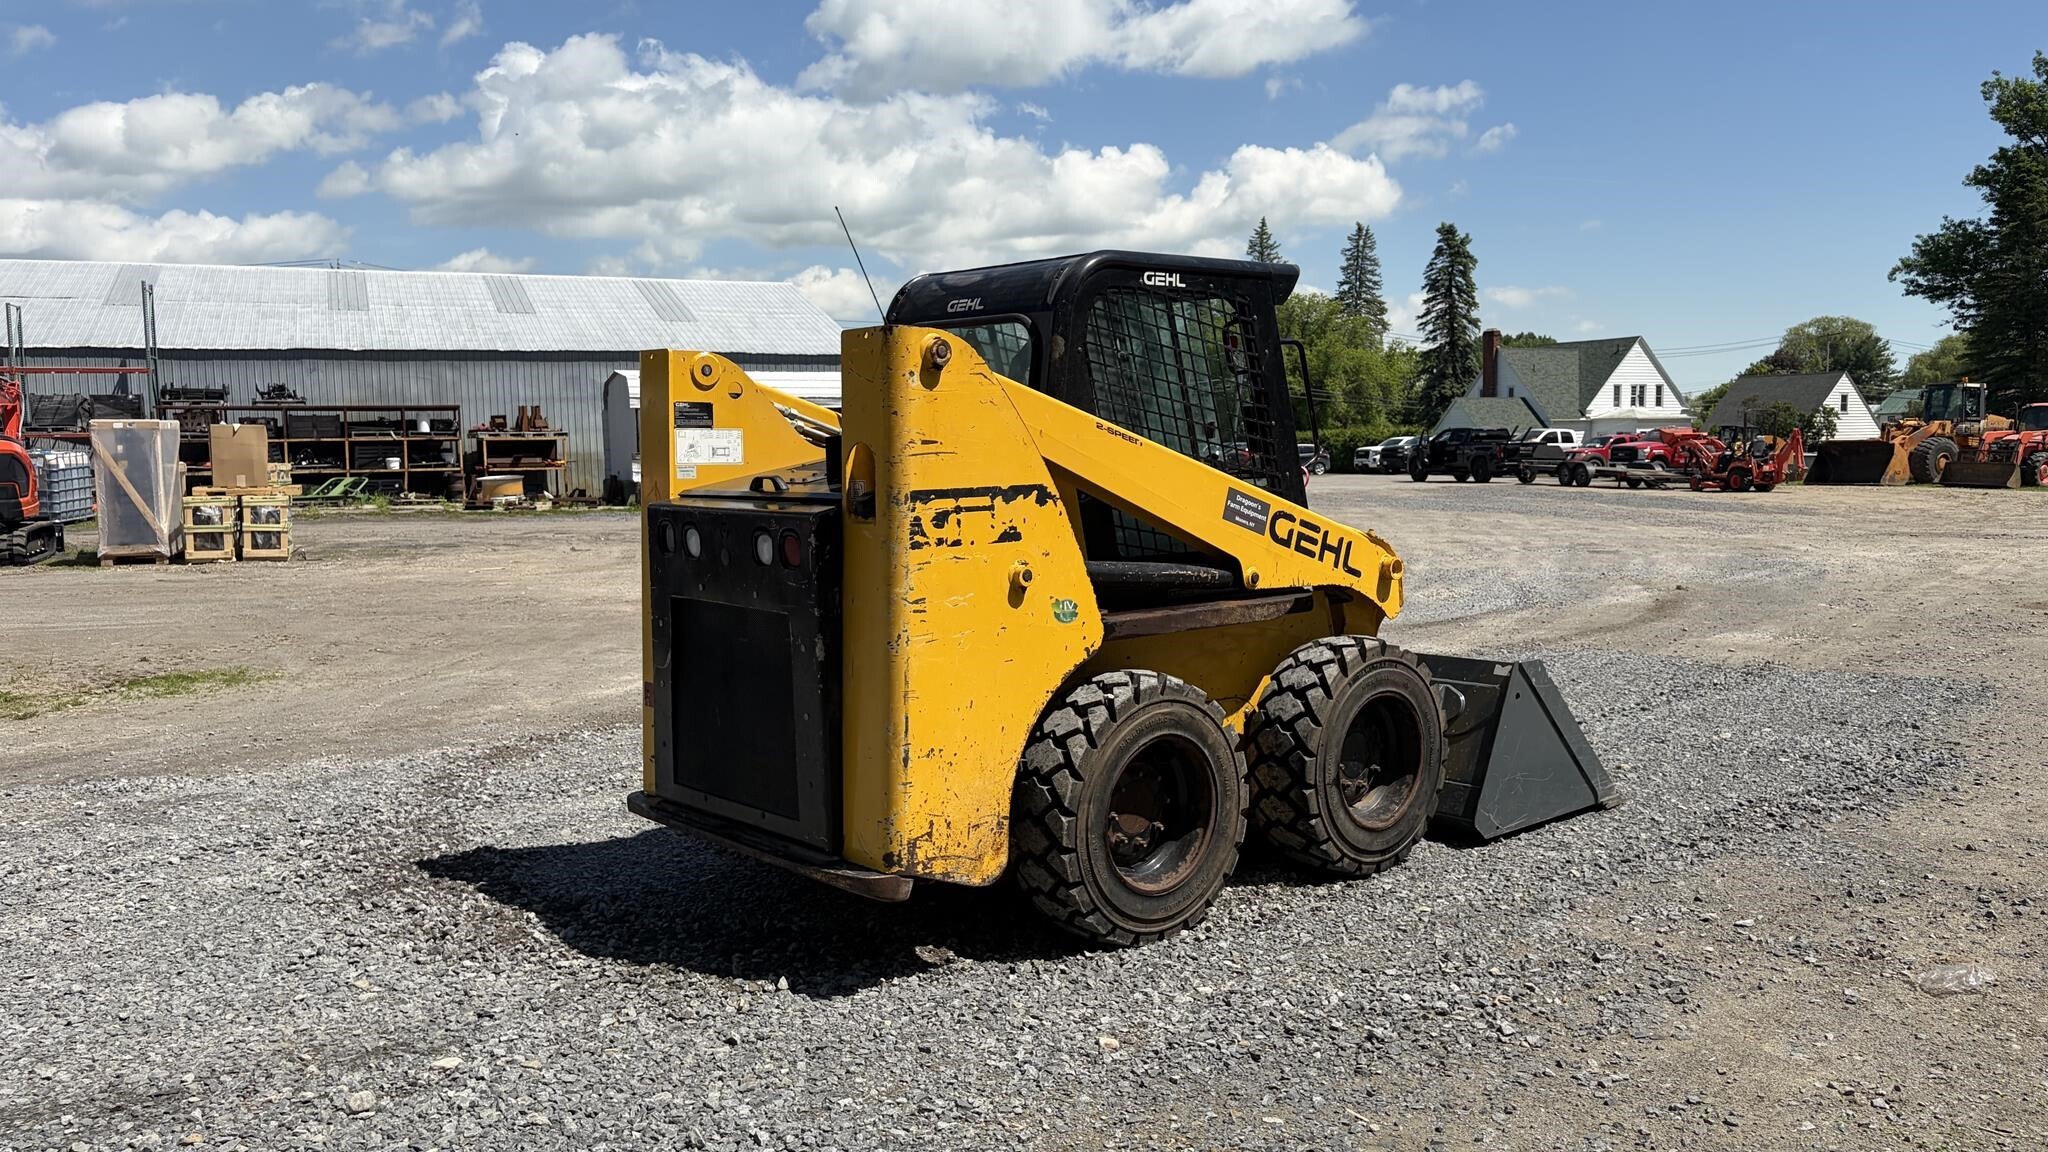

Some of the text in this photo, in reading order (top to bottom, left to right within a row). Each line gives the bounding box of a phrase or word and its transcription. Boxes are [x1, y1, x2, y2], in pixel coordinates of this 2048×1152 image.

[1143, 271, 1186, 288] GEHL
[946, 297, 985, 313] GEHL
[1227, 500, 1266, 521] Farm Equipment
[1236, 495, 1261, 510] Dragoon's
[1269, 510, 1362, 578] GEHL
